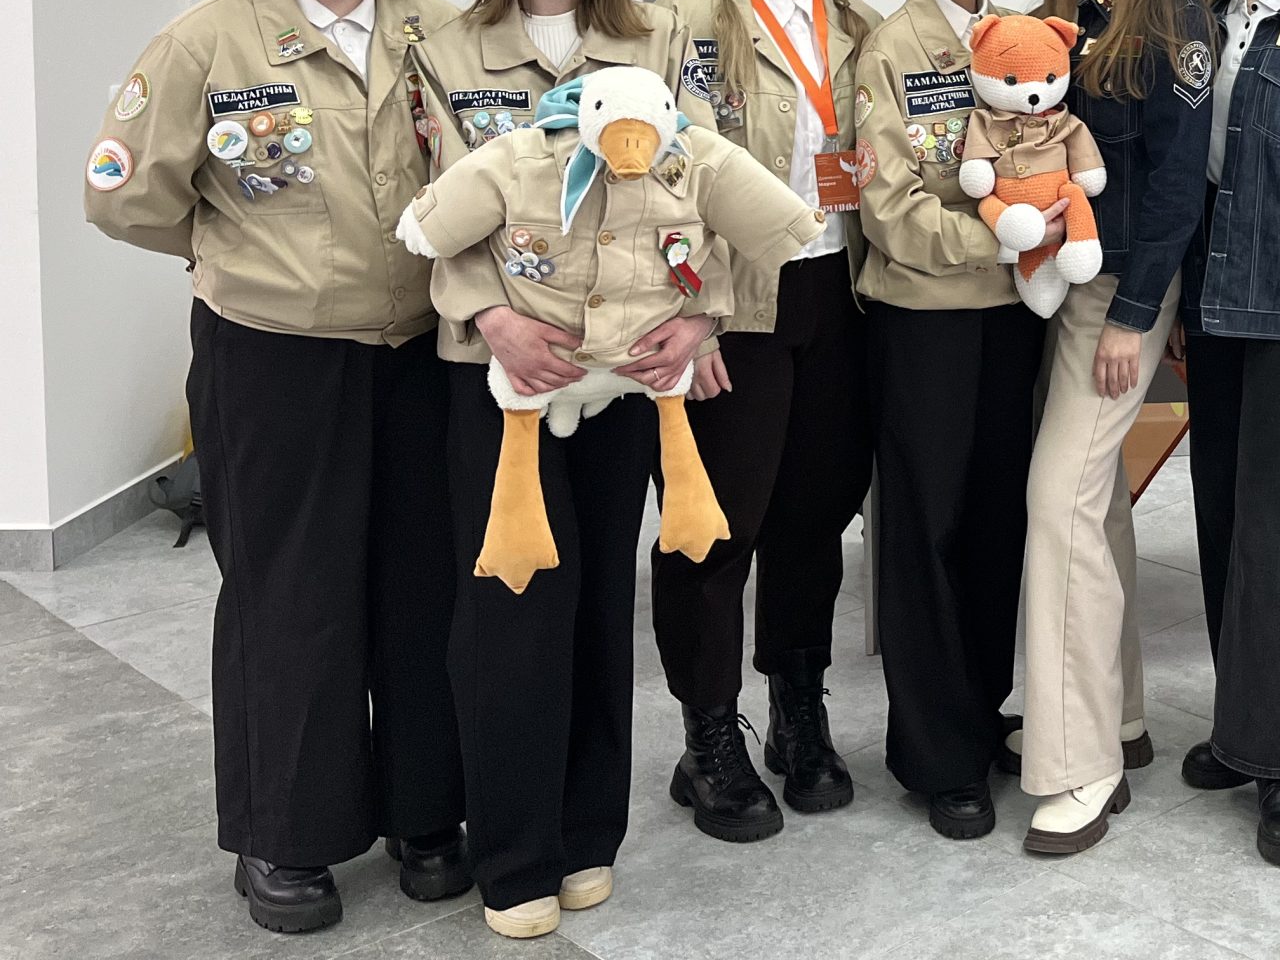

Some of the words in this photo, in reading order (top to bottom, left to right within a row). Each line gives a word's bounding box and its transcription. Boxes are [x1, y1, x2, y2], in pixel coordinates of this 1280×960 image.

[906, 74, 966, 87] КАМАНДЗІР
[214, 85, 293, 103] ПЕДАГАГІЧНЫ
[452, 91, 526, 101] ПЕДАГАГІЧНЫ
[911, 91, 969, 106] ПЕДАГАГІЧНЫ
[237, 97, 269, 110] АТРАД
[471, 98, 502, 107] АТРАД
[930, 100, 956, 111] АТРАД
